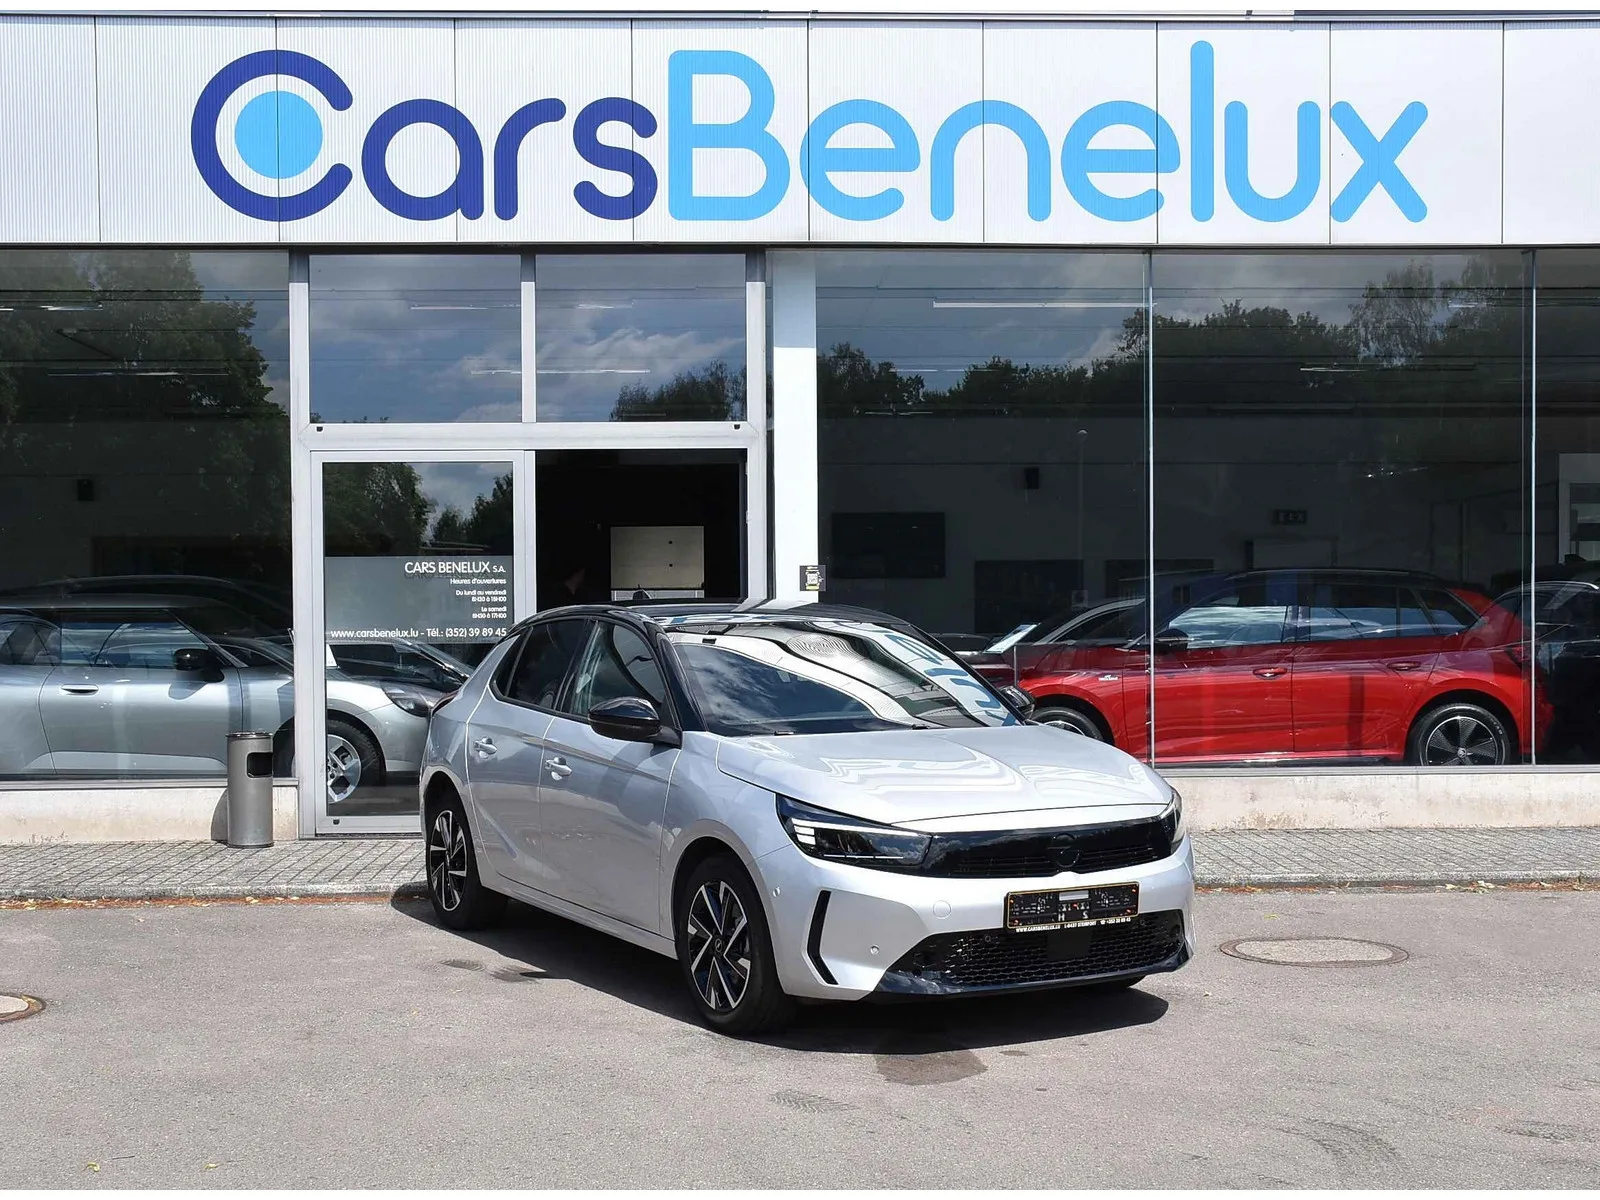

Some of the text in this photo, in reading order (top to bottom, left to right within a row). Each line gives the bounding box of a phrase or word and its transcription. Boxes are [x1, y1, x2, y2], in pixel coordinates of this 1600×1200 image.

[404, 561, 507, 574] CARS BENELUX S.A.
[330, 627, 419, 638] www.carsbenelux.lu
[426, 627, 444, 638] Tél.:
[445, 627, 467, 638] (352)
[468, 628, 480, 637] 39
[481, 628, 494, 637] 89
[495, 628, 507, 637] 45
